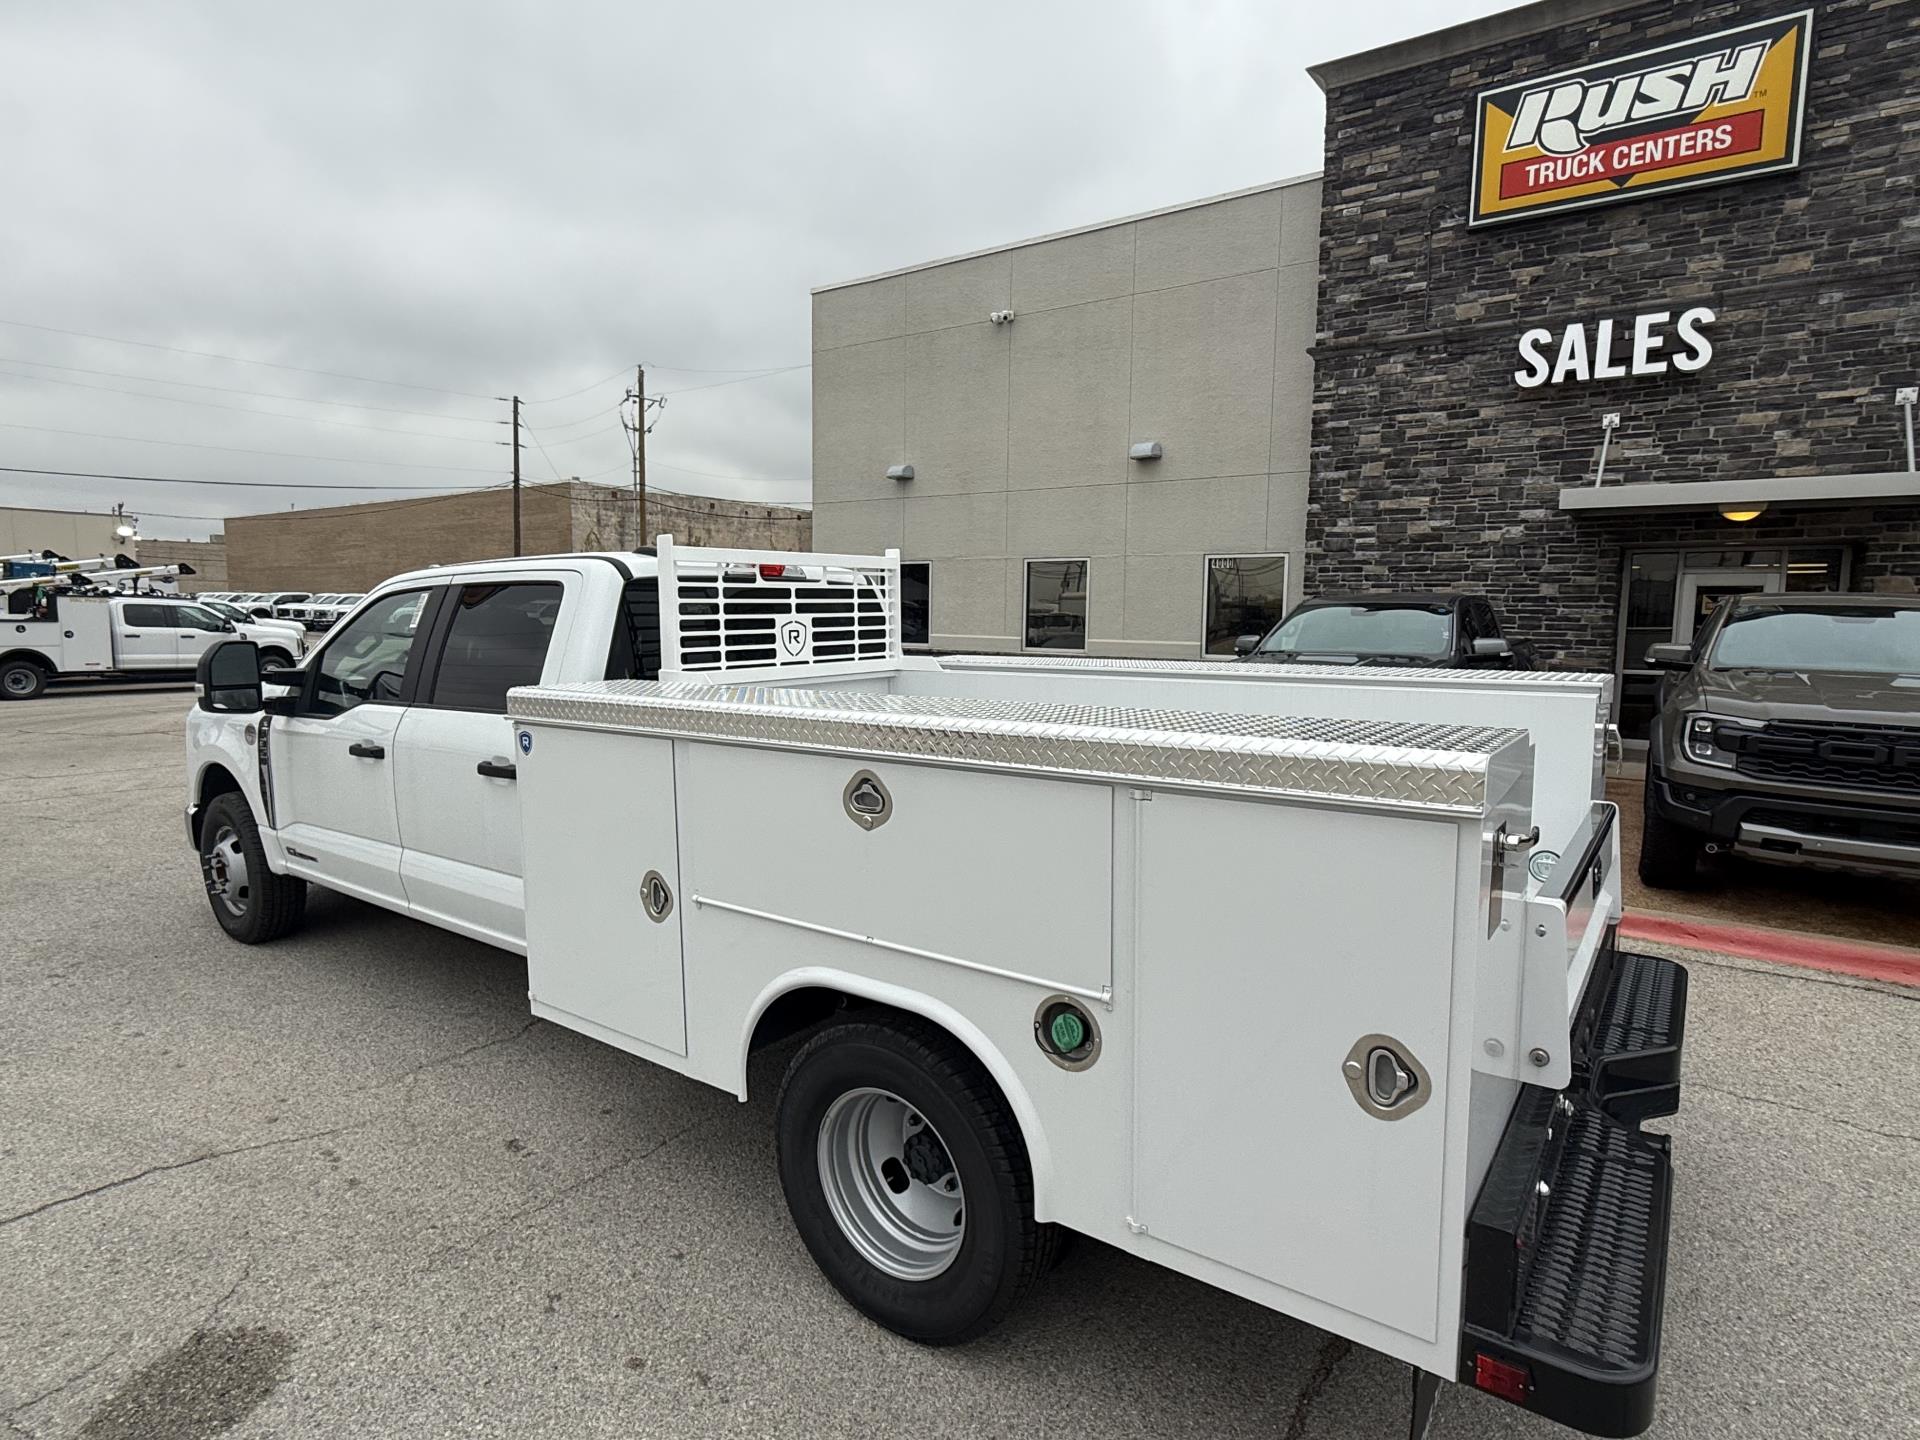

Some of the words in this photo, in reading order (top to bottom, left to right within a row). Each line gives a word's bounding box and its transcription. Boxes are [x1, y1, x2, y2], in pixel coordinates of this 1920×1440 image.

[1503, 39, 1772, 156] RUSH
[1525, 149, 1605, 187] TRUCK
[1612, 124, 1734, 170] CENTERS
[1514, 306, 1717, 388] SALES
[788, 629, 801, 644] R
[522, 736, 530, 748] R
